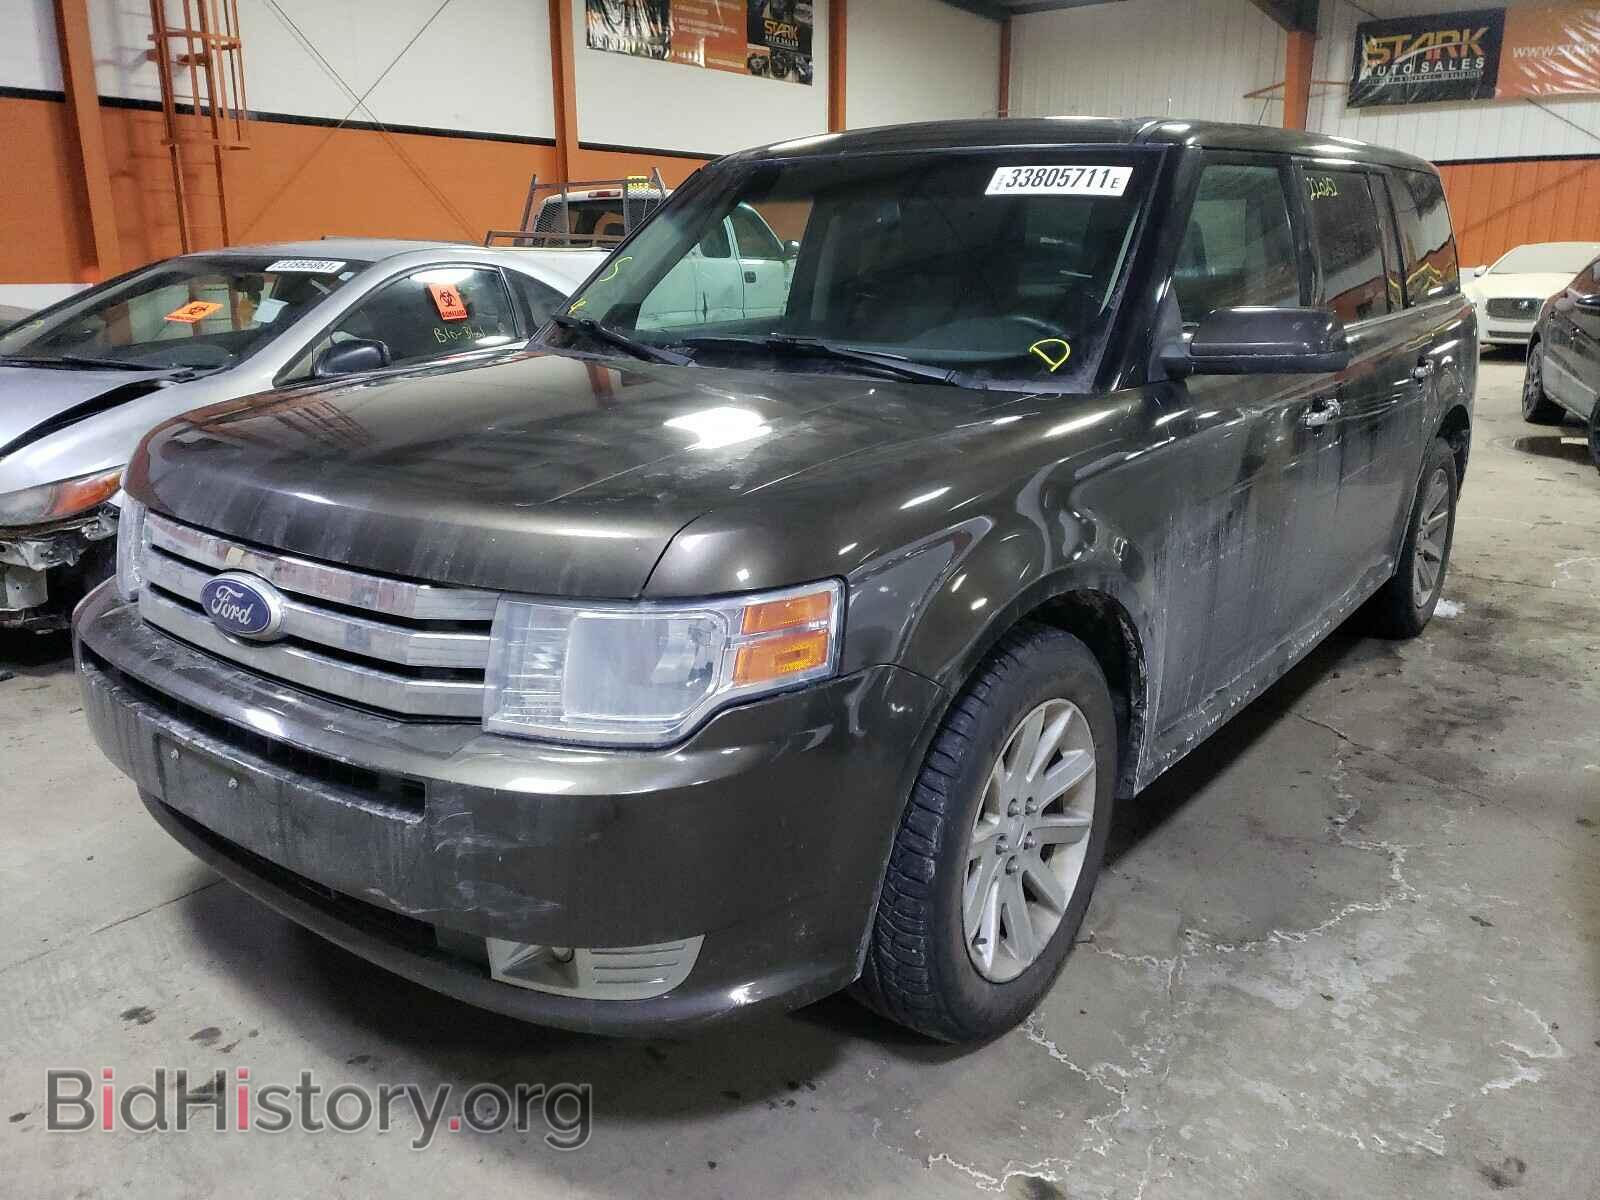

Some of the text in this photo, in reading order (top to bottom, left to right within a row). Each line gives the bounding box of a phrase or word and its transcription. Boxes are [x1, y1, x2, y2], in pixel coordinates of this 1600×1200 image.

[765, 20, 798, 40] STARK
[1366, 27, 1489, 65] STARK
[1361, 57, 1485, 77] AUTO SALES
[1005, 168, 1111, 188] 33805711
[1110, 177, 1120, 188] E
[211, 585, 254, 625] Ford
